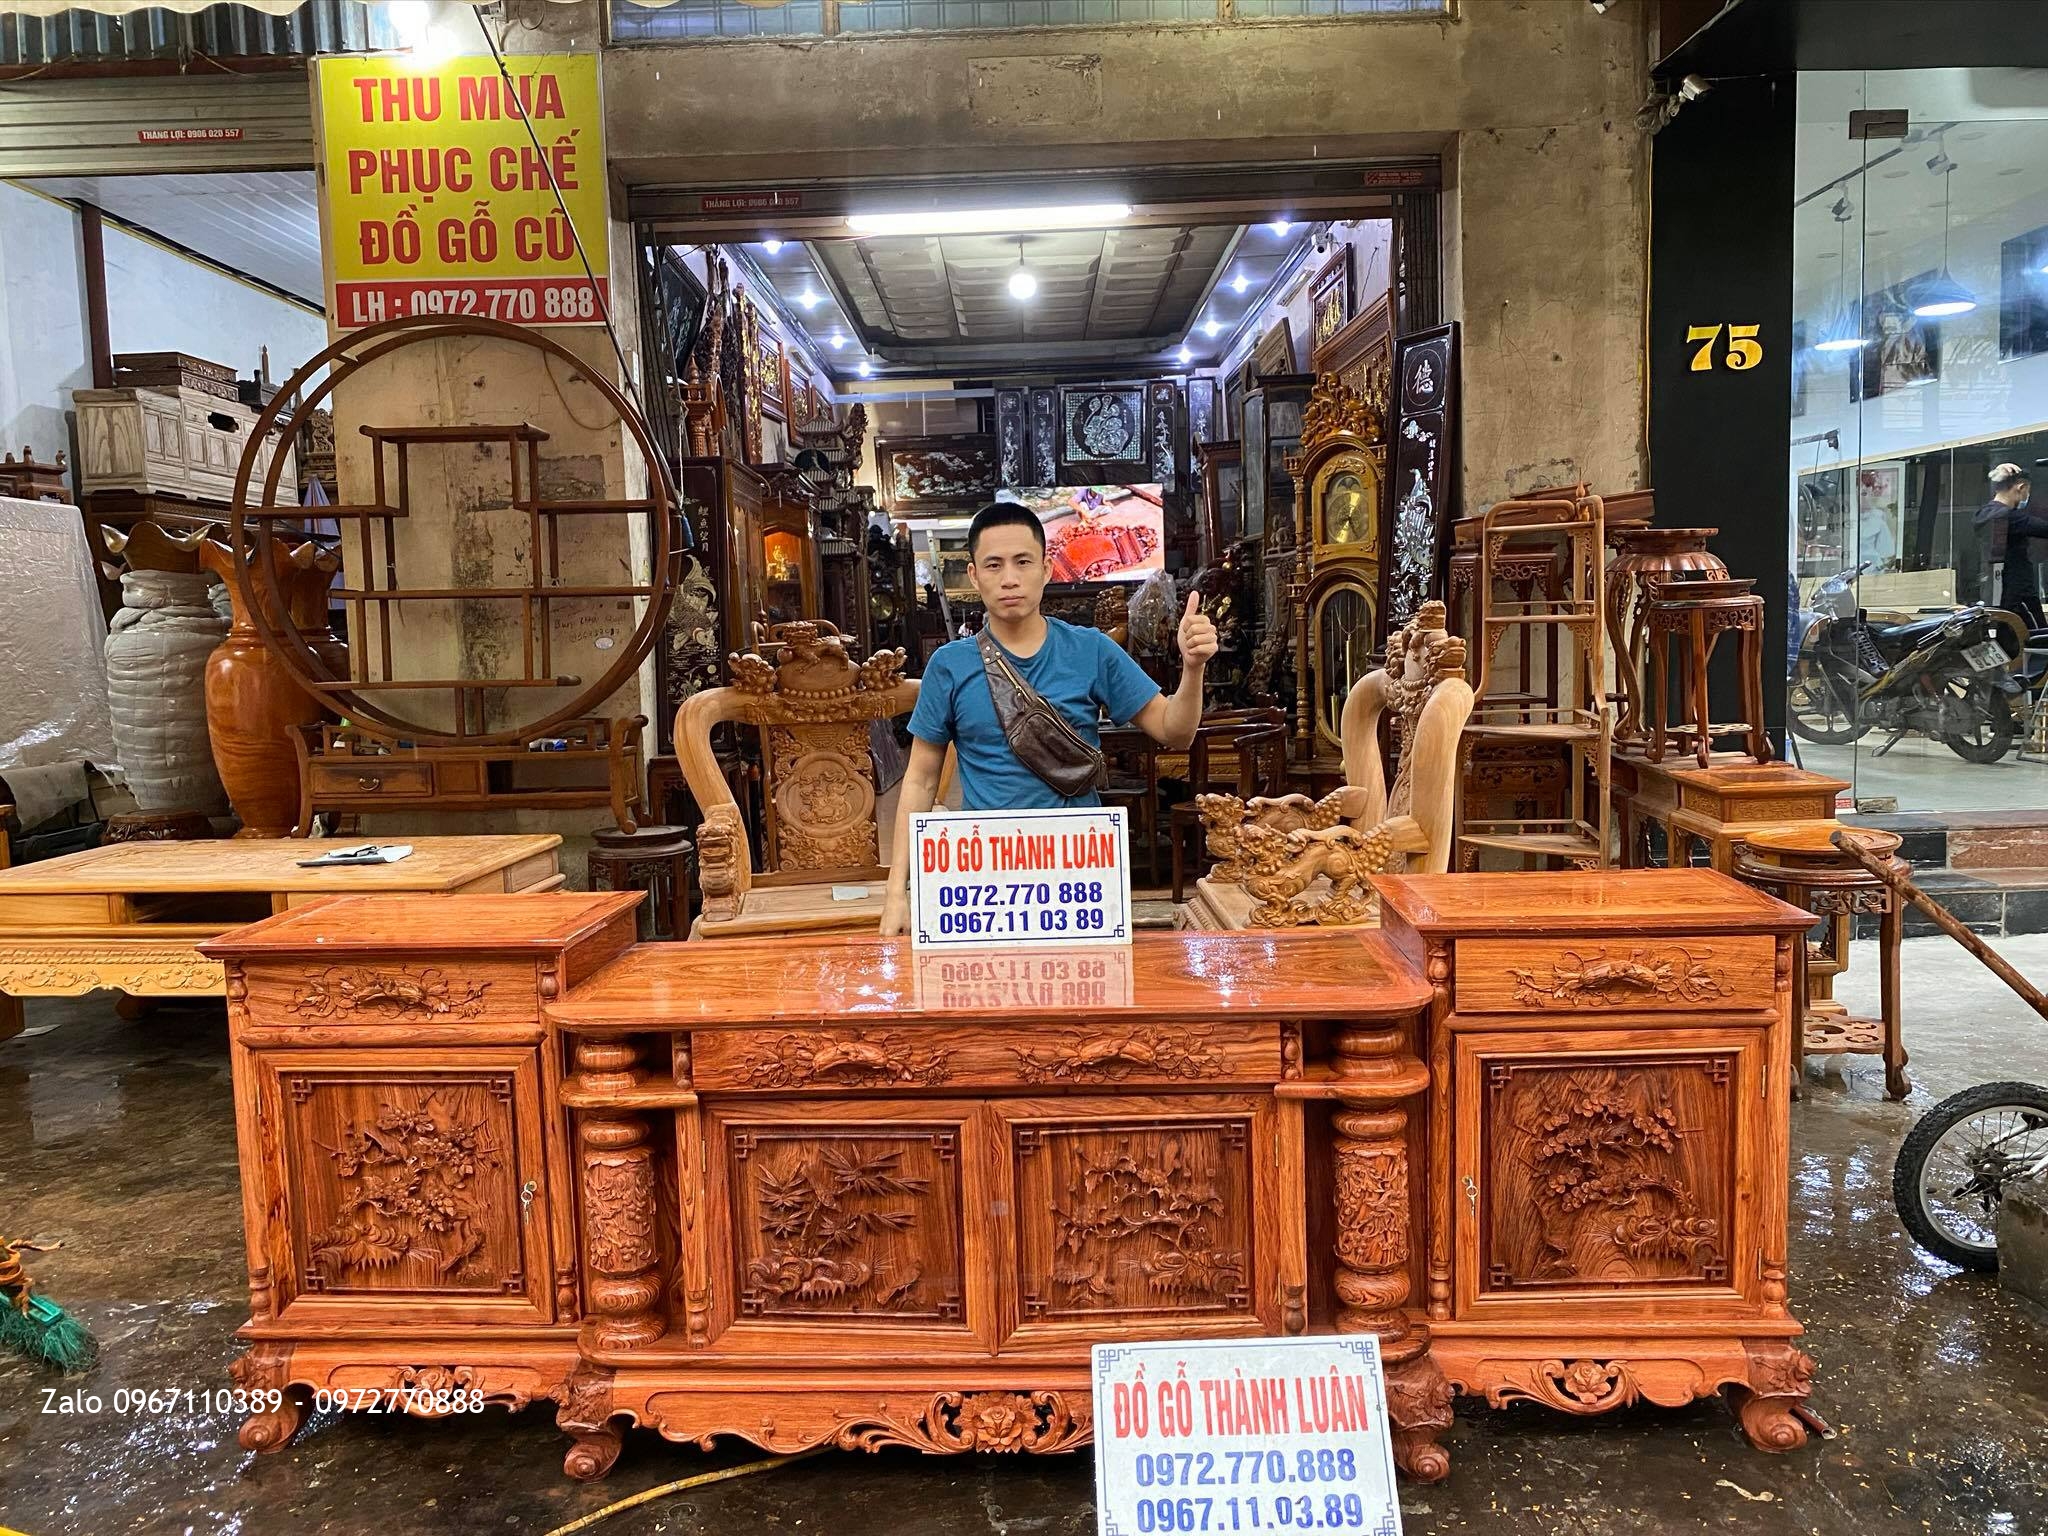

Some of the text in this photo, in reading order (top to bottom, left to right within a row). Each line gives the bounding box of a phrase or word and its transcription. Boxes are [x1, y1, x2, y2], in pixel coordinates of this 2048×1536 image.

[353, 74, 566, 123] THU MUA
[348, 129, 581, 203] PHỤC CHẾ
[359, 200, 575, 265] ĐỒ GỖ CŨ
[352, 290, 386, 322] LH
[411, 287, 536, 320] 0972.770
[545, 286, 594, 318] 888
[1686, 323, 1763, 371] 75
[923, 824, 1115, 873] ĐỒ GỖ THÀNH LUÂN
[939, 881, 1103, 908] 0972.770 888
[940, 908, 1104, 934] 0967.11 03 89
[1113, 1360, 1369, 1438] ĐỒ GỖ THÀNH LUÂN
[1136, 1448, 1357, 1487] 0972.770.888
[1136, 1493, 1364, 1533] 0967.11.03.89
